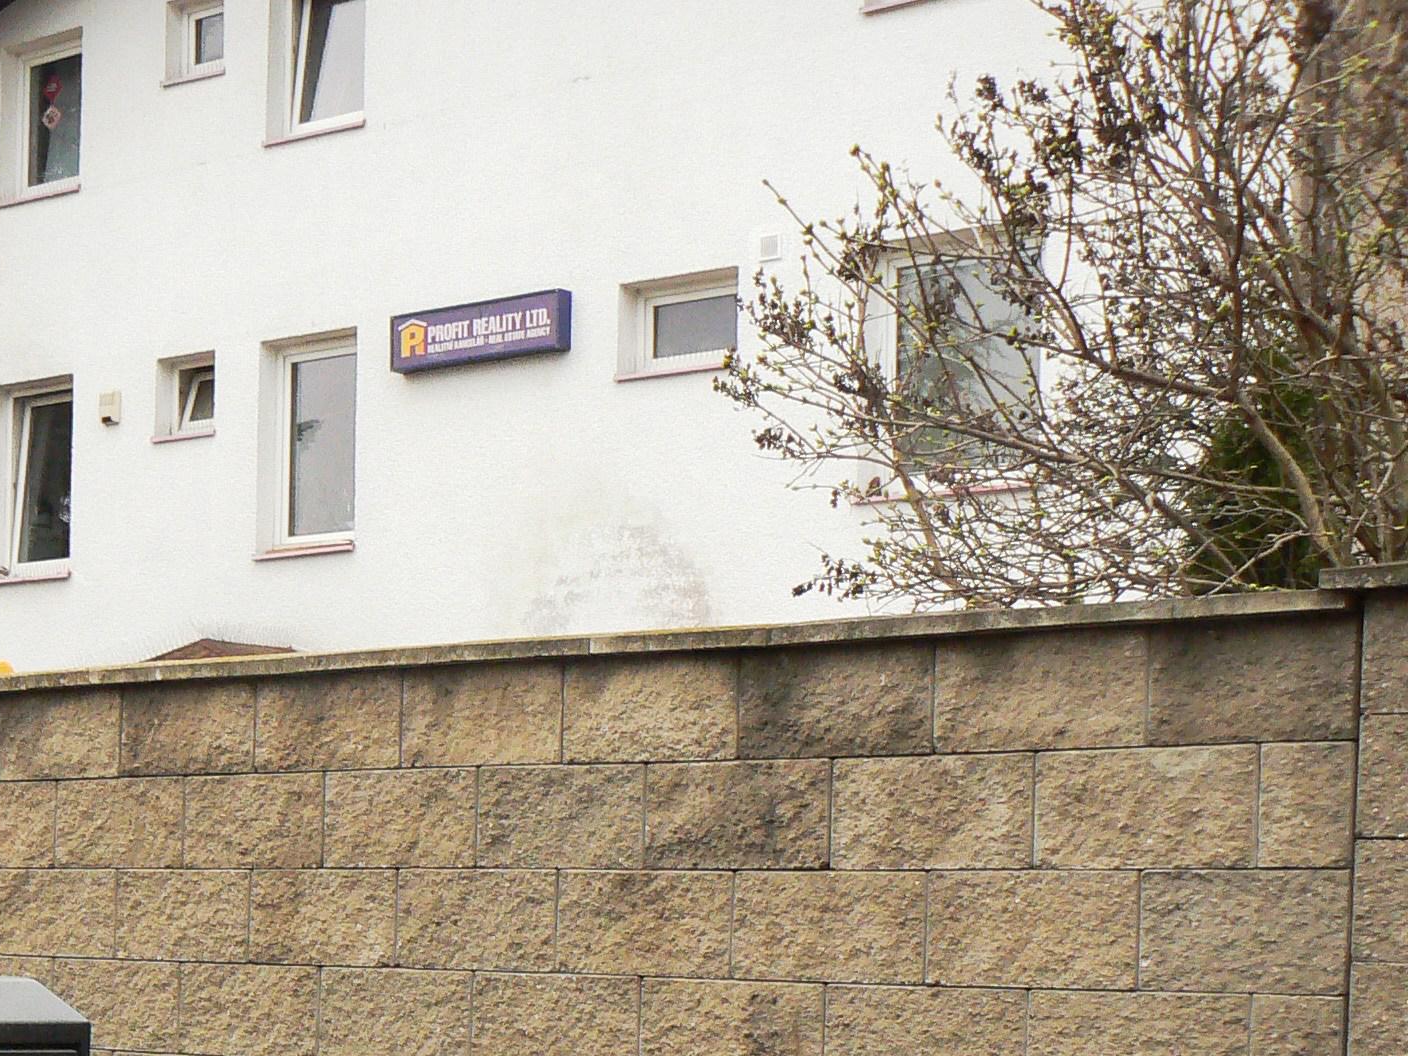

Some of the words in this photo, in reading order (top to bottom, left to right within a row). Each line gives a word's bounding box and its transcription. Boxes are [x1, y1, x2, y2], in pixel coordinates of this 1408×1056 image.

[428, 321, 469, 342] PROFIT
[473, 312, 523, 336] REALITY
[525, 307, 551, 328] LTD.
